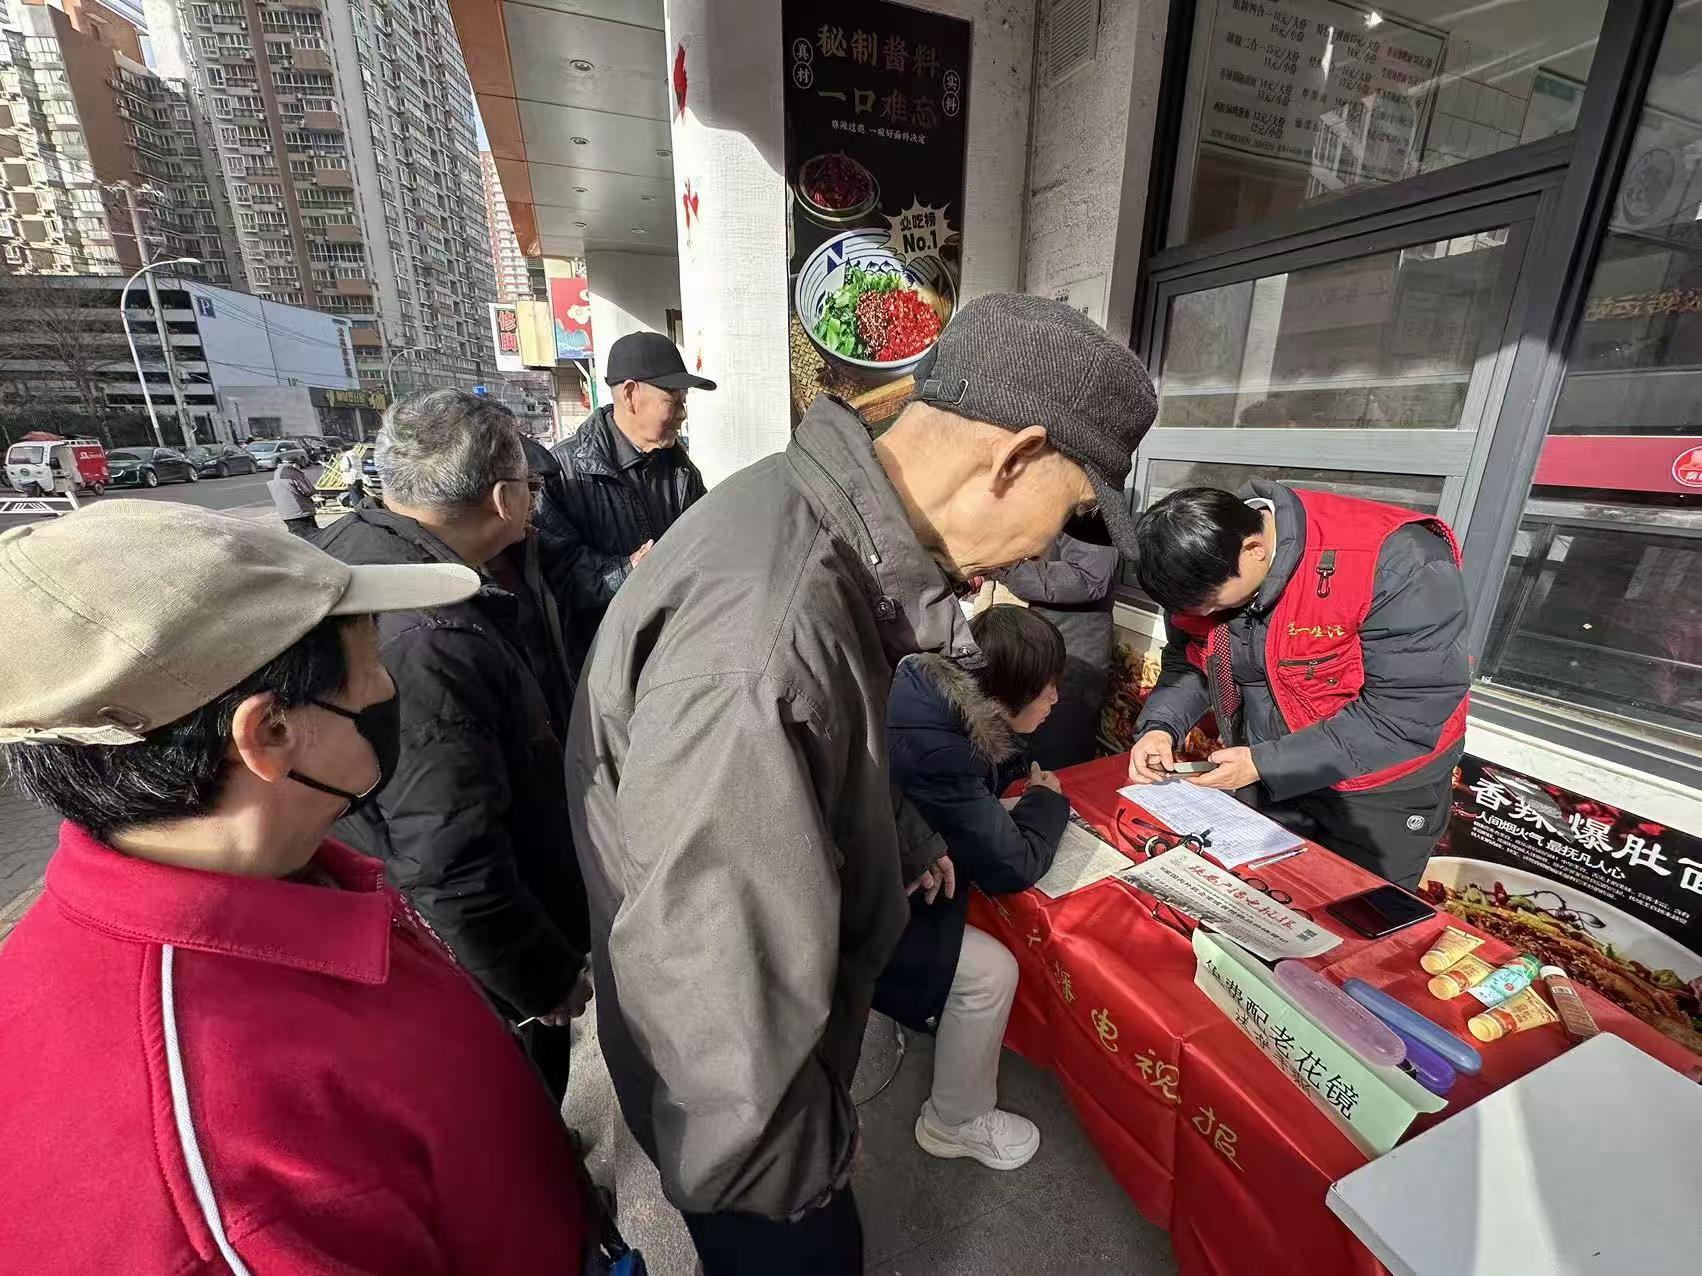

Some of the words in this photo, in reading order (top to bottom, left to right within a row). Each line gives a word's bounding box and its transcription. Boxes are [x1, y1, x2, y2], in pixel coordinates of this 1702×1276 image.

[796, 42, 812, 85] 真材
[816, 23, 941, 78] 秘制酱料
[817, 87, 940, 129] 一口难忘
[944, 73, 958, 113] 实料
[831, 119, 866, 135] 麻辣过瘾
[900, 211, 936, 231] 必吃榜
[903, 229, 937, 253] No.1
[1475, 810, 1544, 848] 人间烟火气
[1545, 839, 1626, 880] 最抚凡人心
[1188, 864, 1296, 931] 陕西广播电视报
[1205, 959, 1360, 1121] 免费配老花镜
